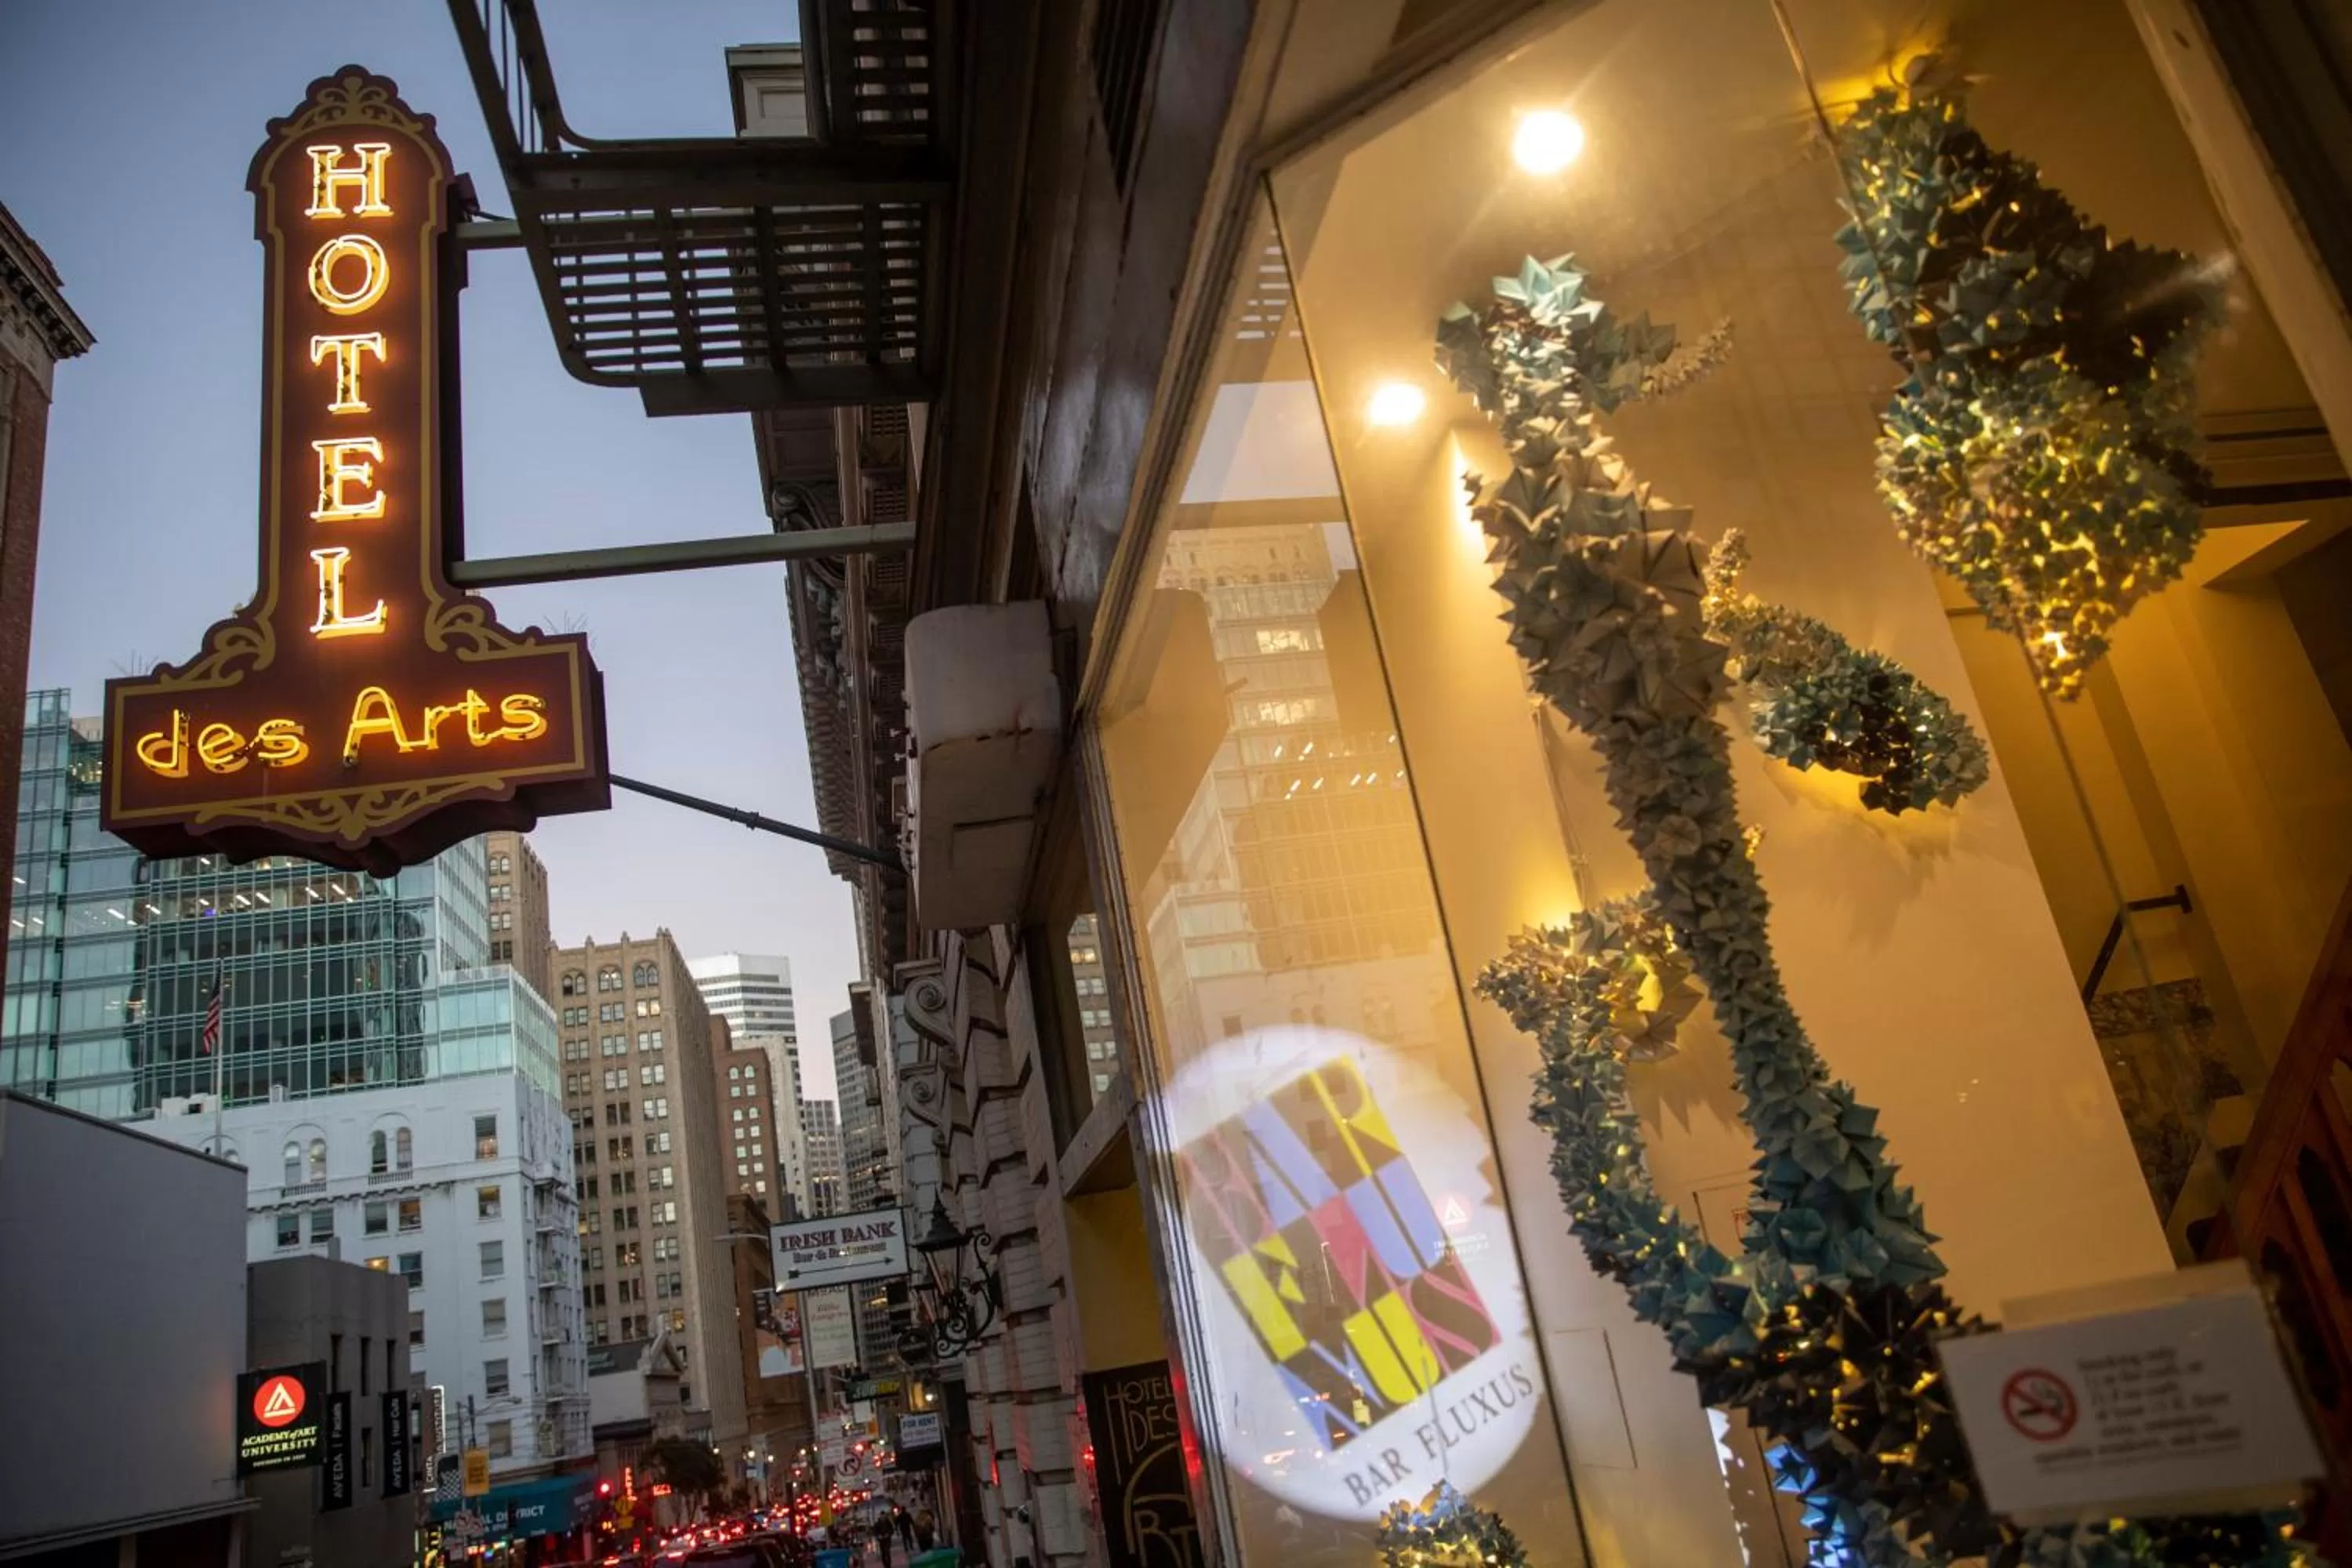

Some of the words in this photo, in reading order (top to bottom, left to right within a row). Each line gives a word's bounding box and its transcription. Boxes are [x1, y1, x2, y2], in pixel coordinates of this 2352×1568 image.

[305, 142, 394, 639] HOTEL
[136, 709, 310, 778] des
[343, 686, 547, 768] Arts
[779, 1229, 837, 1252] IRISH
[840, 1221, 898, 1243] BANK
[241, 1430, 290, 1446] ACADEMY
[298, 1425, 318, 1437] ART
[241, 1436, 318, 1458] UNIVERSITY
[1102, 1374, 1175, 1486] HOTEL
[1342, 1446, 1414, 1508] BAR
[1414, 1363, 1534, 1461] FLUXUS
[332, 1453, 344, 1499] AVEDA
[392, 1449, 402, 1489] AVEDA
